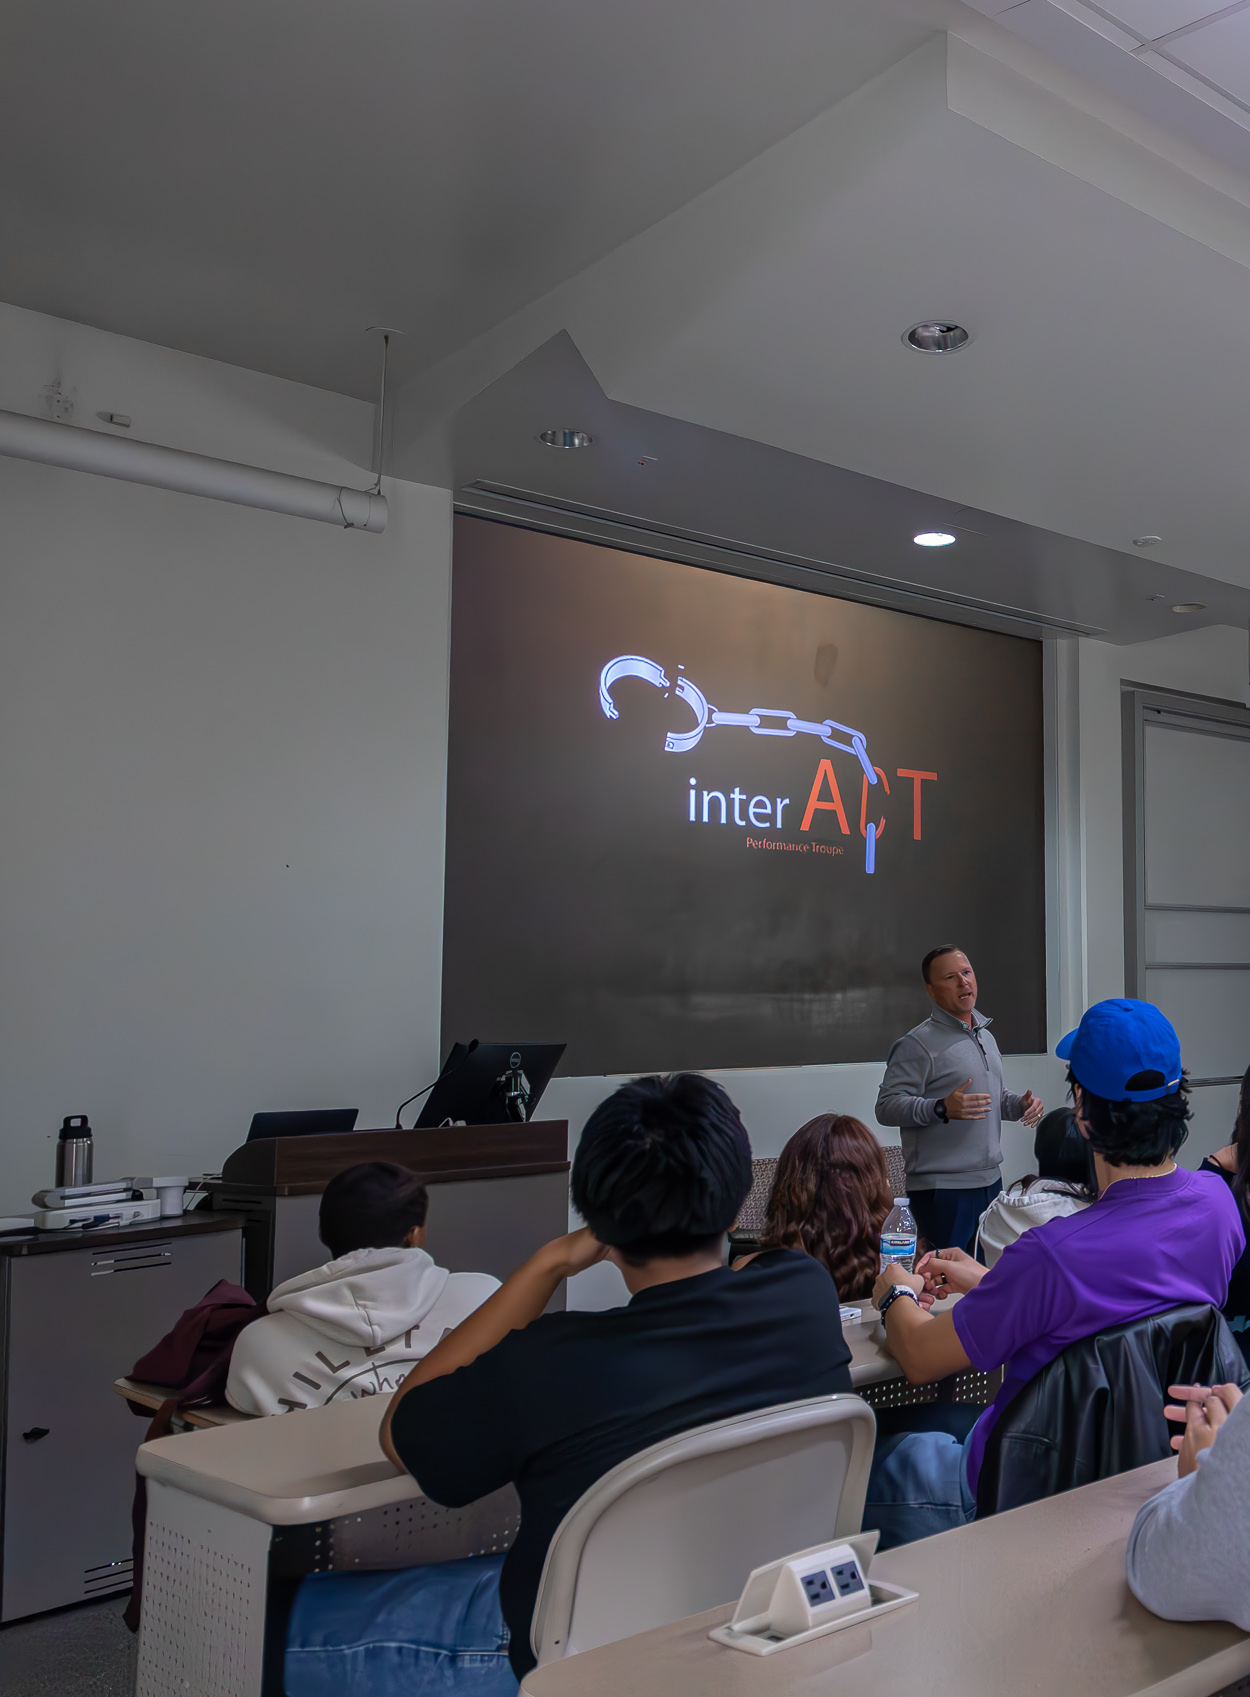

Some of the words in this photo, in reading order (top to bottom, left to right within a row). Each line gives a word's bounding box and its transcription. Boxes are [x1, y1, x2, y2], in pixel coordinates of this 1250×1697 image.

[688, 777, 790, 829] inter
[746, 836, 810, 853] Performance
[811, 841, 845, 857] Troupe
